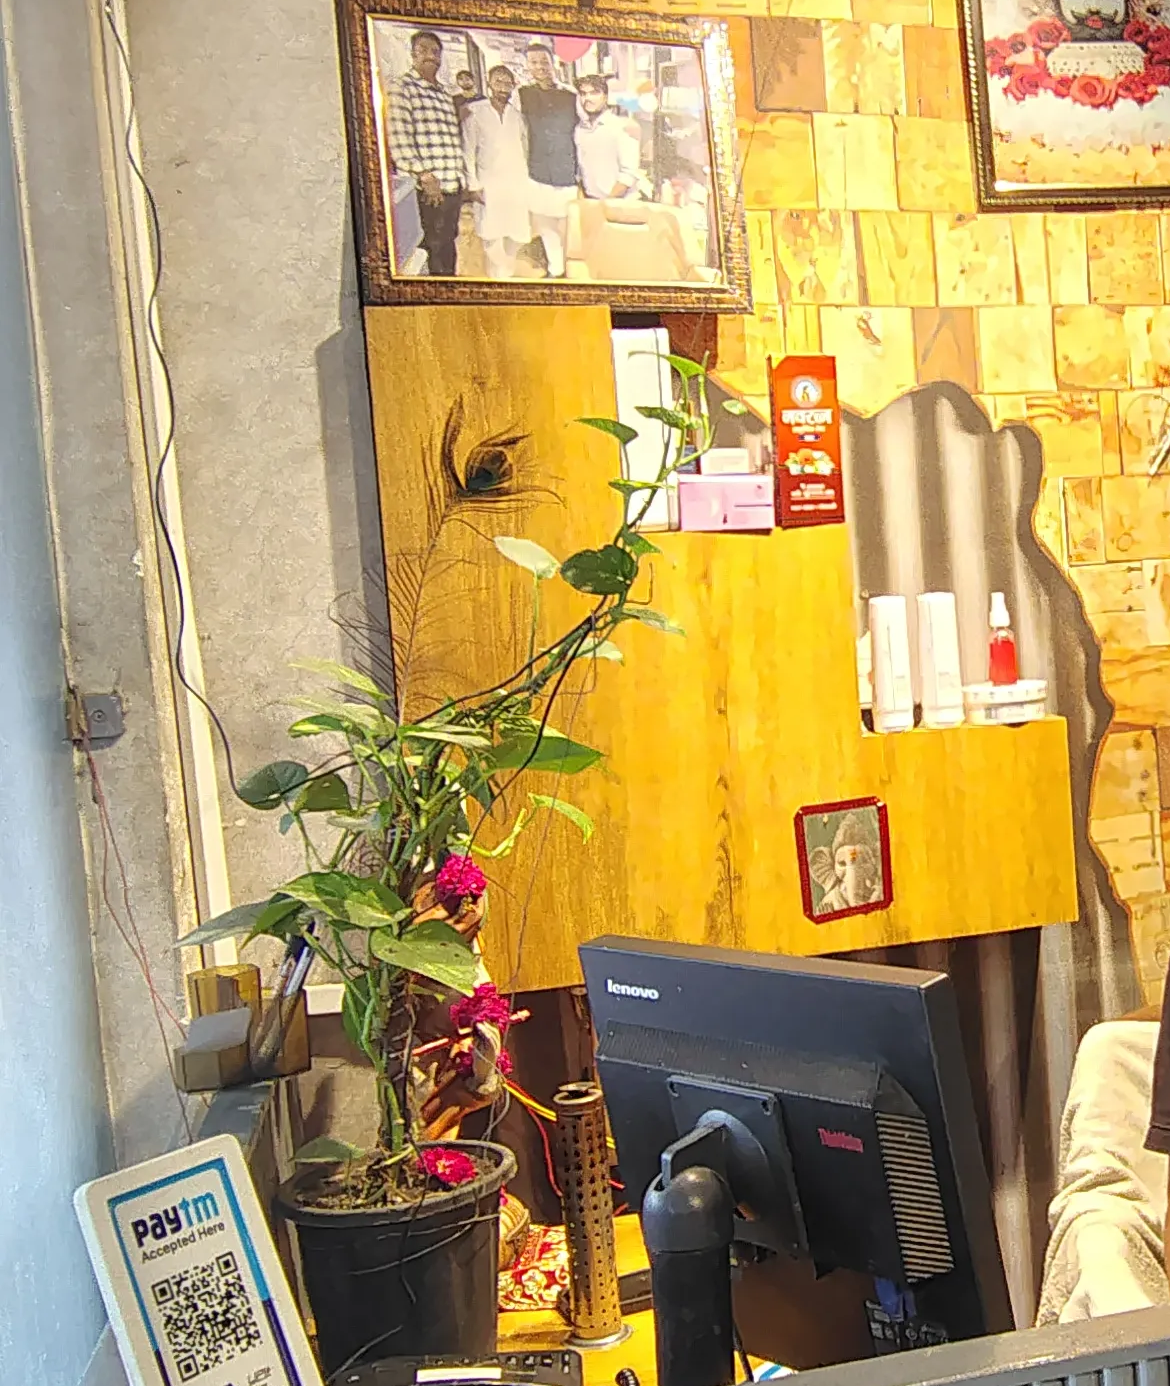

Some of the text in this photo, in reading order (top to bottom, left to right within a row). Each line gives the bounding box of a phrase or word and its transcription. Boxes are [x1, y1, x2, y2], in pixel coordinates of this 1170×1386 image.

[606, 978, 660, 1000] lenovo
[141, 1221, 225, 1264] Accepted Here
